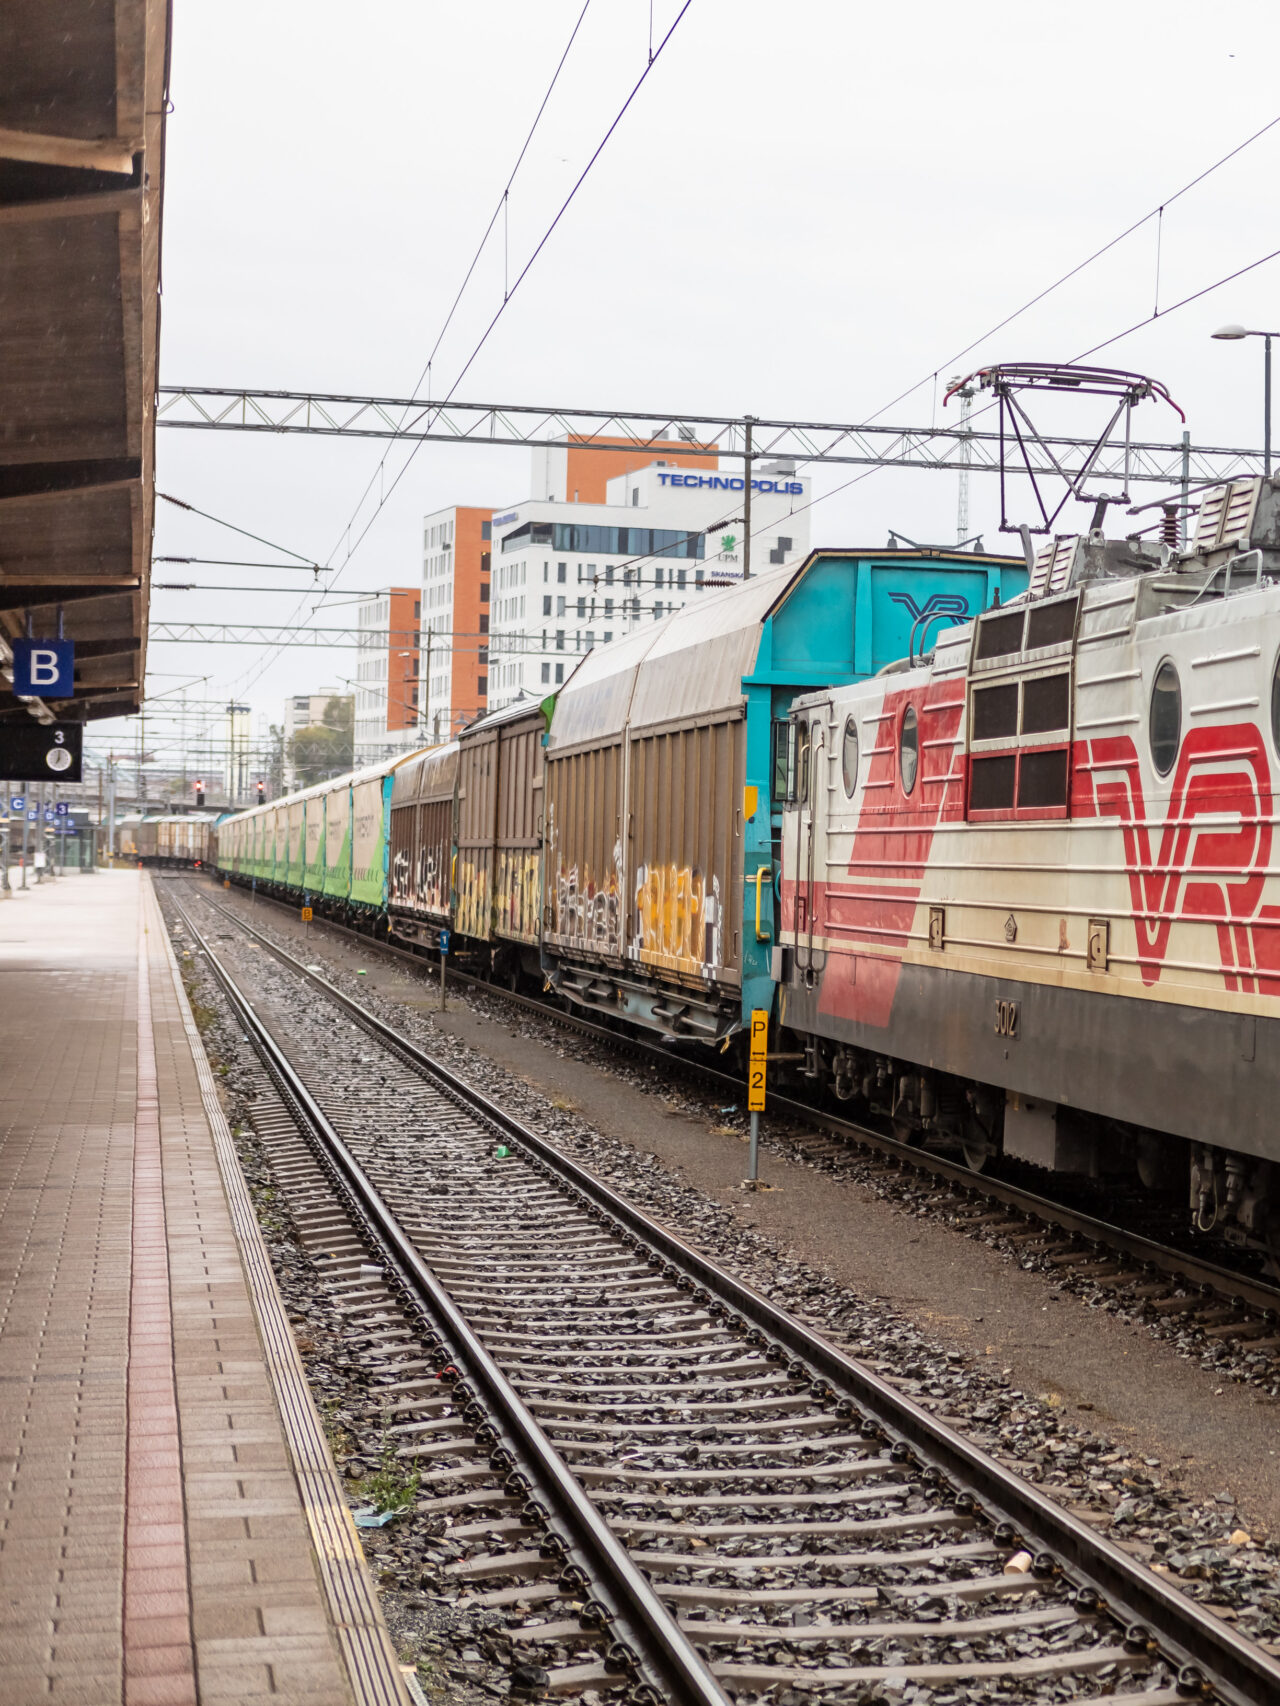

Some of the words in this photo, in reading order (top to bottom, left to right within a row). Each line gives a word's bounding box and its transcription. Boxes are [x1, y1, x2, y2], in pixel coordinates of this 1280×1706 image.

[657, 473, 804, 495] TECHNOPOLIS
[717, 554, 738, 562] UPM
[711, 570, 744, 579] SKANSKA
[888, 592, 969, 625] VR
[30, 649, 60, 685] B
[54, 731, 65, 744] 3
[13, 799, 23, 809] C
[59, 804, 67, 814] 3
[1090, 722, 1273, 992] VR
[993, 999, 1016, 1036] 3012
[753, 1021, 765, 1038] P
[751, 1072, 764, 1089] 2
